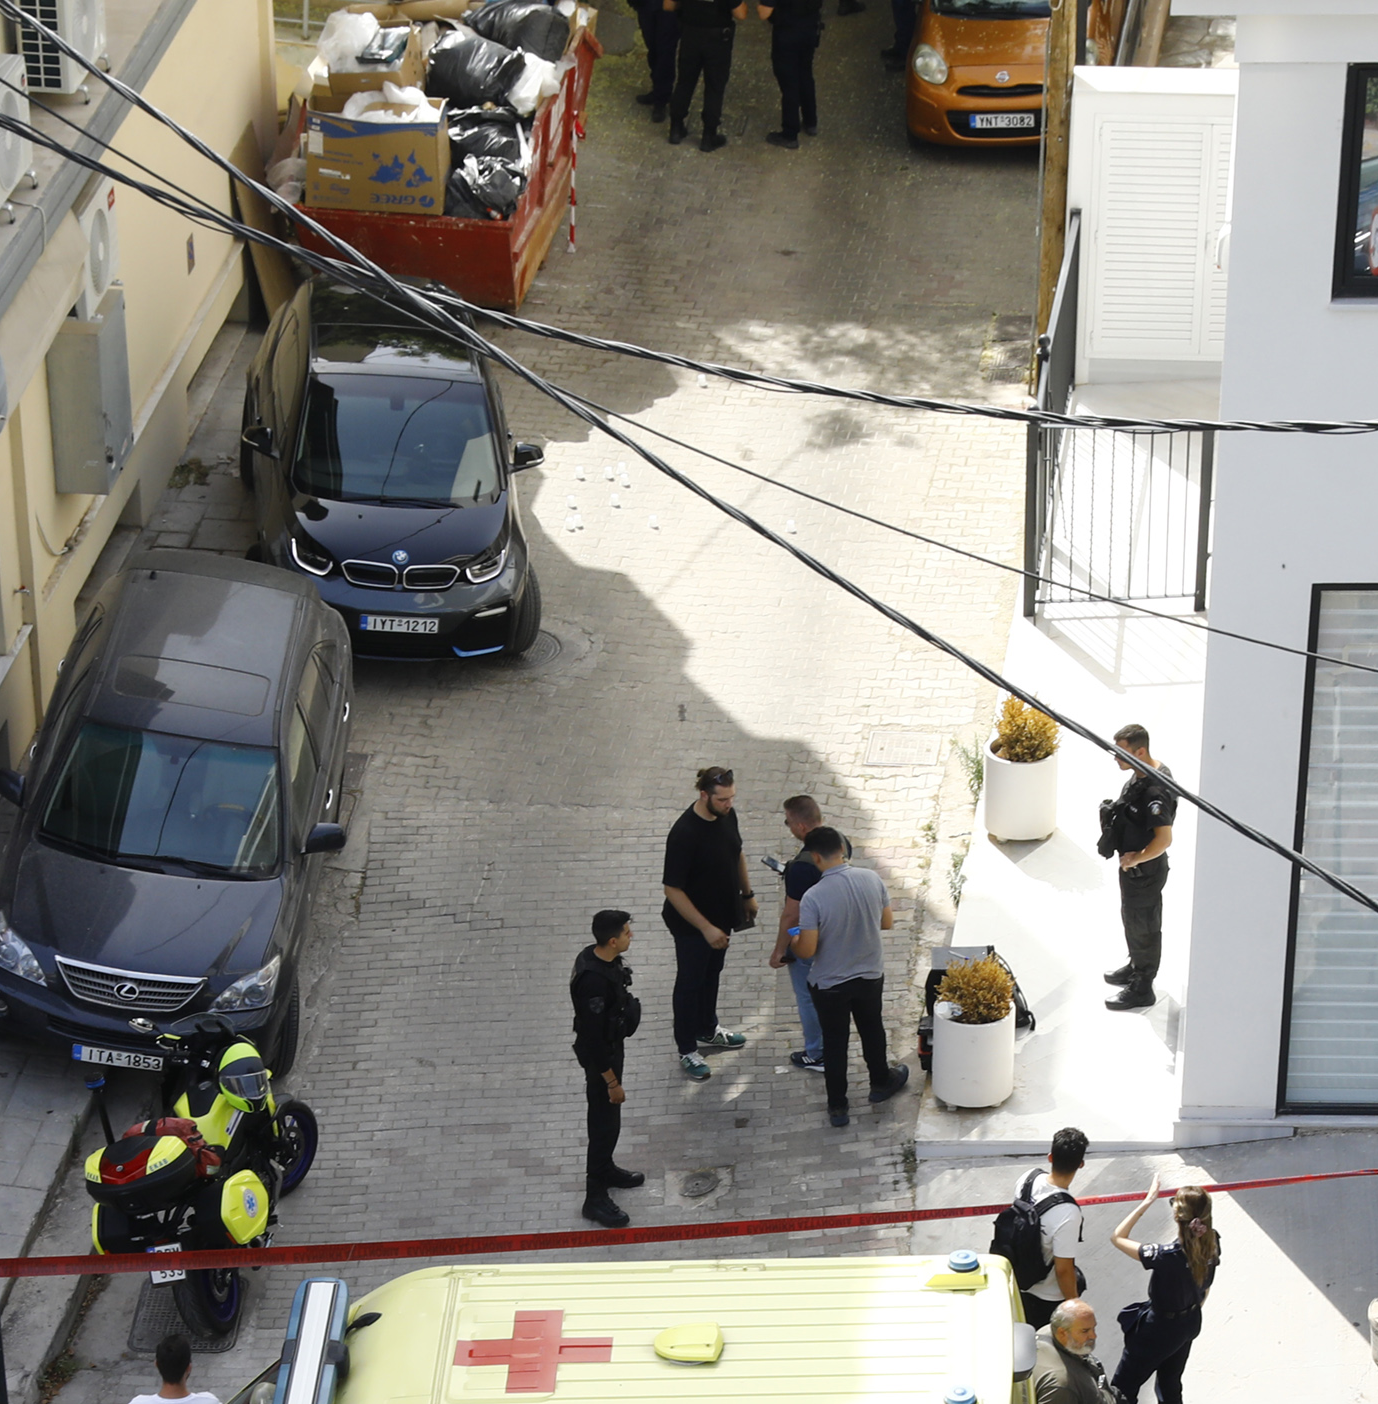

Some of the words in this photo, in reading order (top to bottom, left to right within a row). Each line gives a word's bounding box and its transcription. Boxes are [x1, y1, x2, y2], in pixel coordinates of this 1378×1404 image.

[372, 193, 416, 206] GREE
[373, 618, 437, 632] IYT-1212
[89, 1049, 161, 1070] ITA-1853
